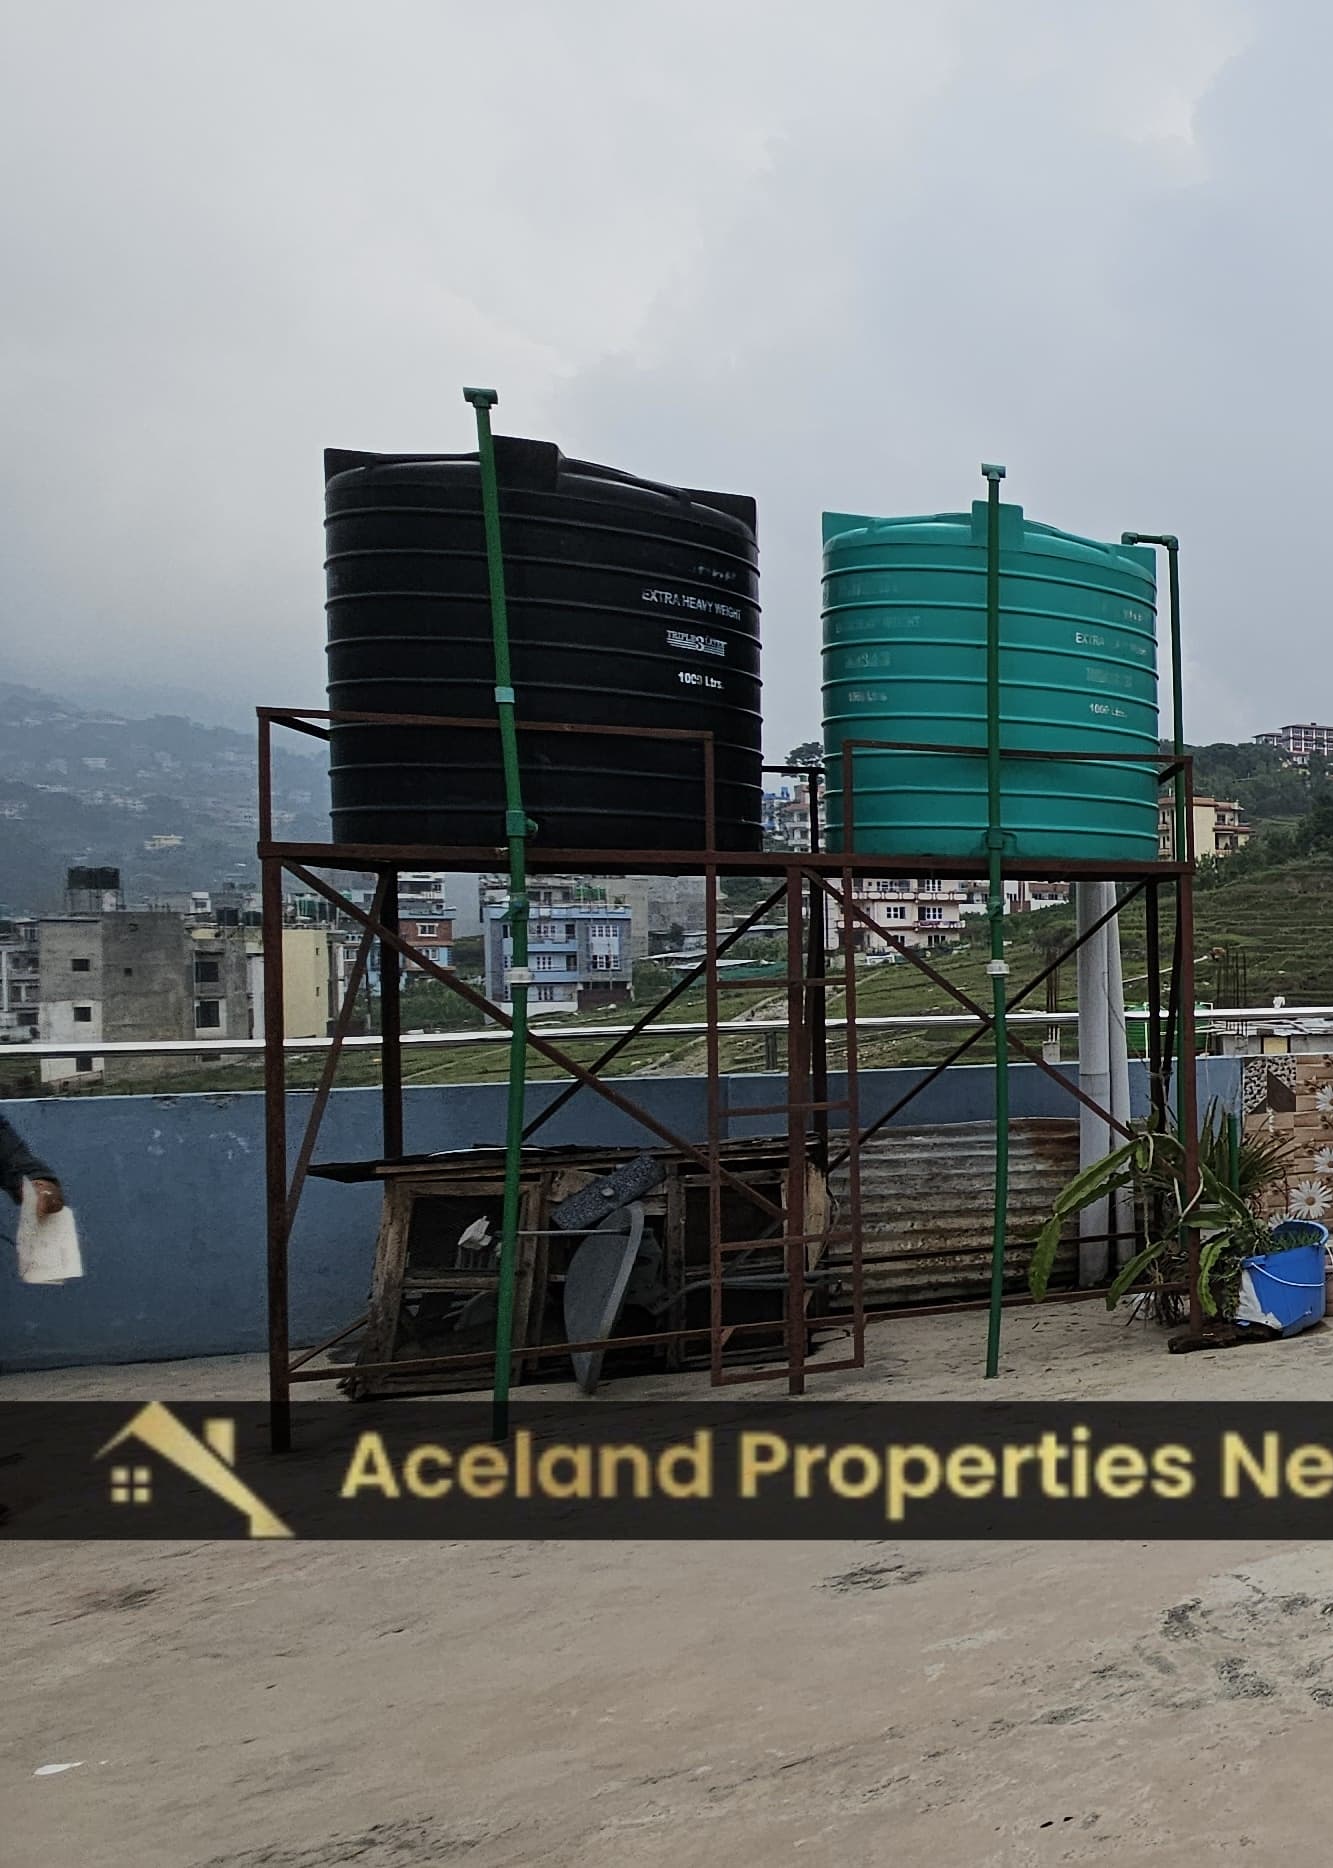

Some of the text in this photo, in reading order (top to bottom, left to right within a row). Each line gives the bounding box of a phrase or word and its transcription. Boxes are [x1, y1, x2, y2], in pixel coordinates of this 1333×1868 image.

[641, 588, 742, 621] EXTRA HEAVY WEIGHT
